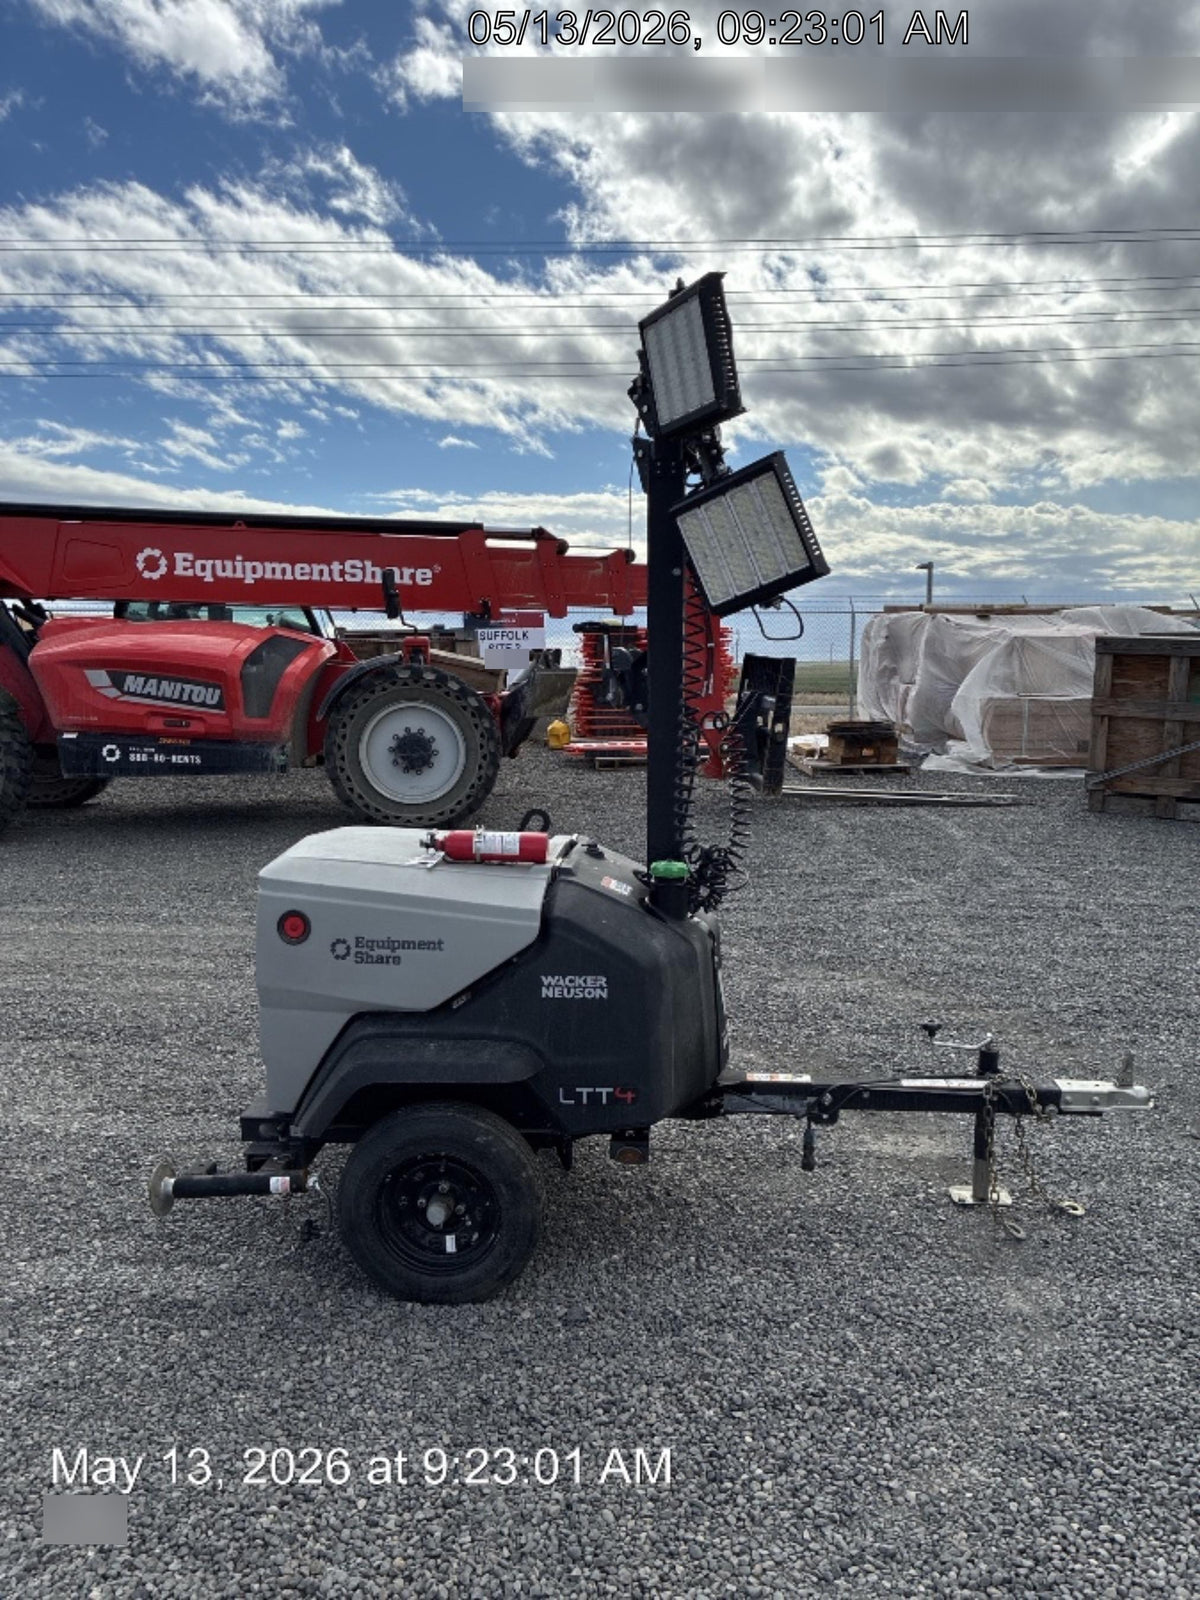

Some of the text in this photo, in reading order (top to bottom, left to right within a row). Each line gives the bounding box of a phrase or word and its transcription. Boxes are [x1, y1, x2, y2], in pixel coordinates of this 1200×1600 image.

[479, 630, 529, 641] SUFFOLK
[123, 674, 221, 705] MANITOU
[354, 936, 445, 953] Equipment
[354, 951, 402, 965] Share
[540, 975, 608, 987] WACKER
[541, 987, 608, 999] NEUSON
